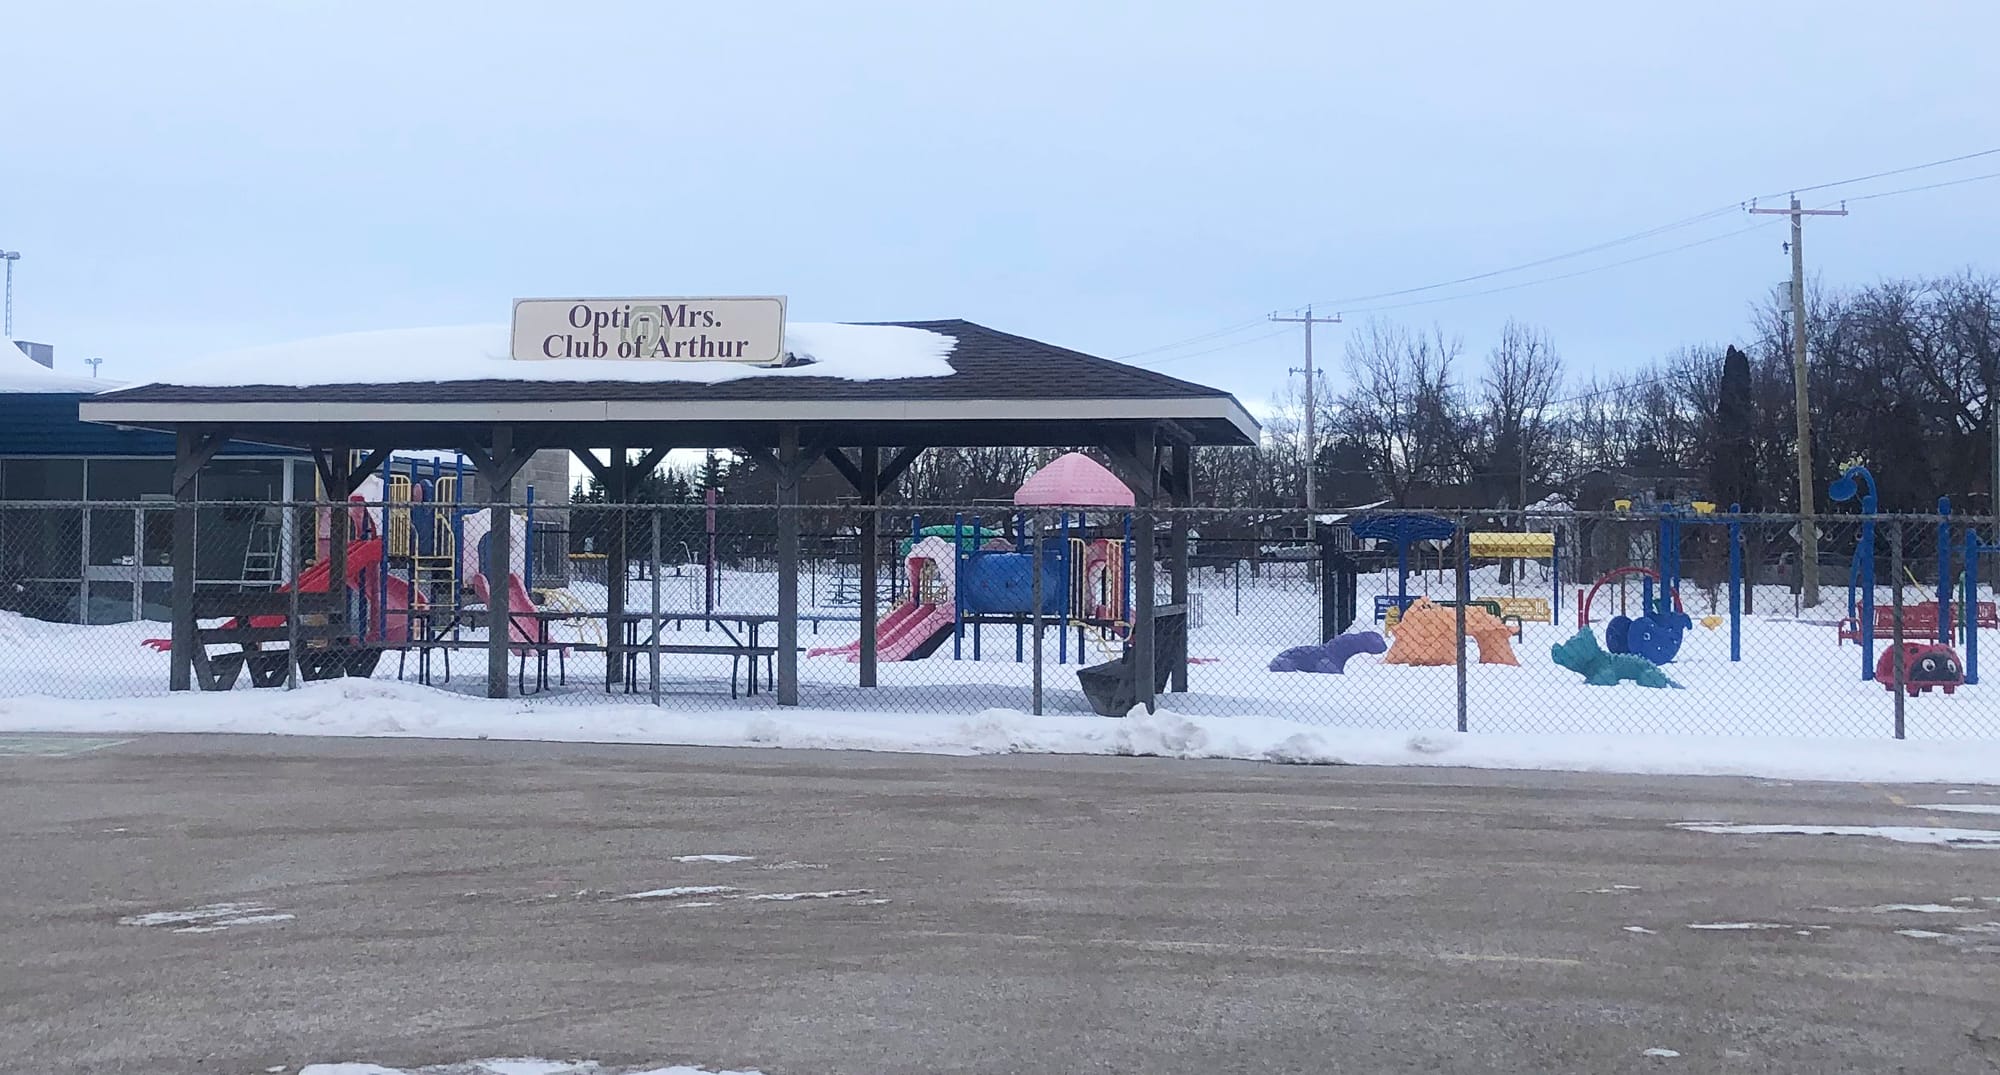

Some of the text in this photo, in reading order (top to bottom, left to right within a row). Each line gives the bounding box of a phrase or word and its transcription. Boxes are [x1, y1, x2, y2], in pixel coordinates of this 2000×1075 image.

[568, 304, 630, 334] Opti
[659, 304, 722, 328] Mrs.
[542, 334, 749, 358] Club of Arthur
